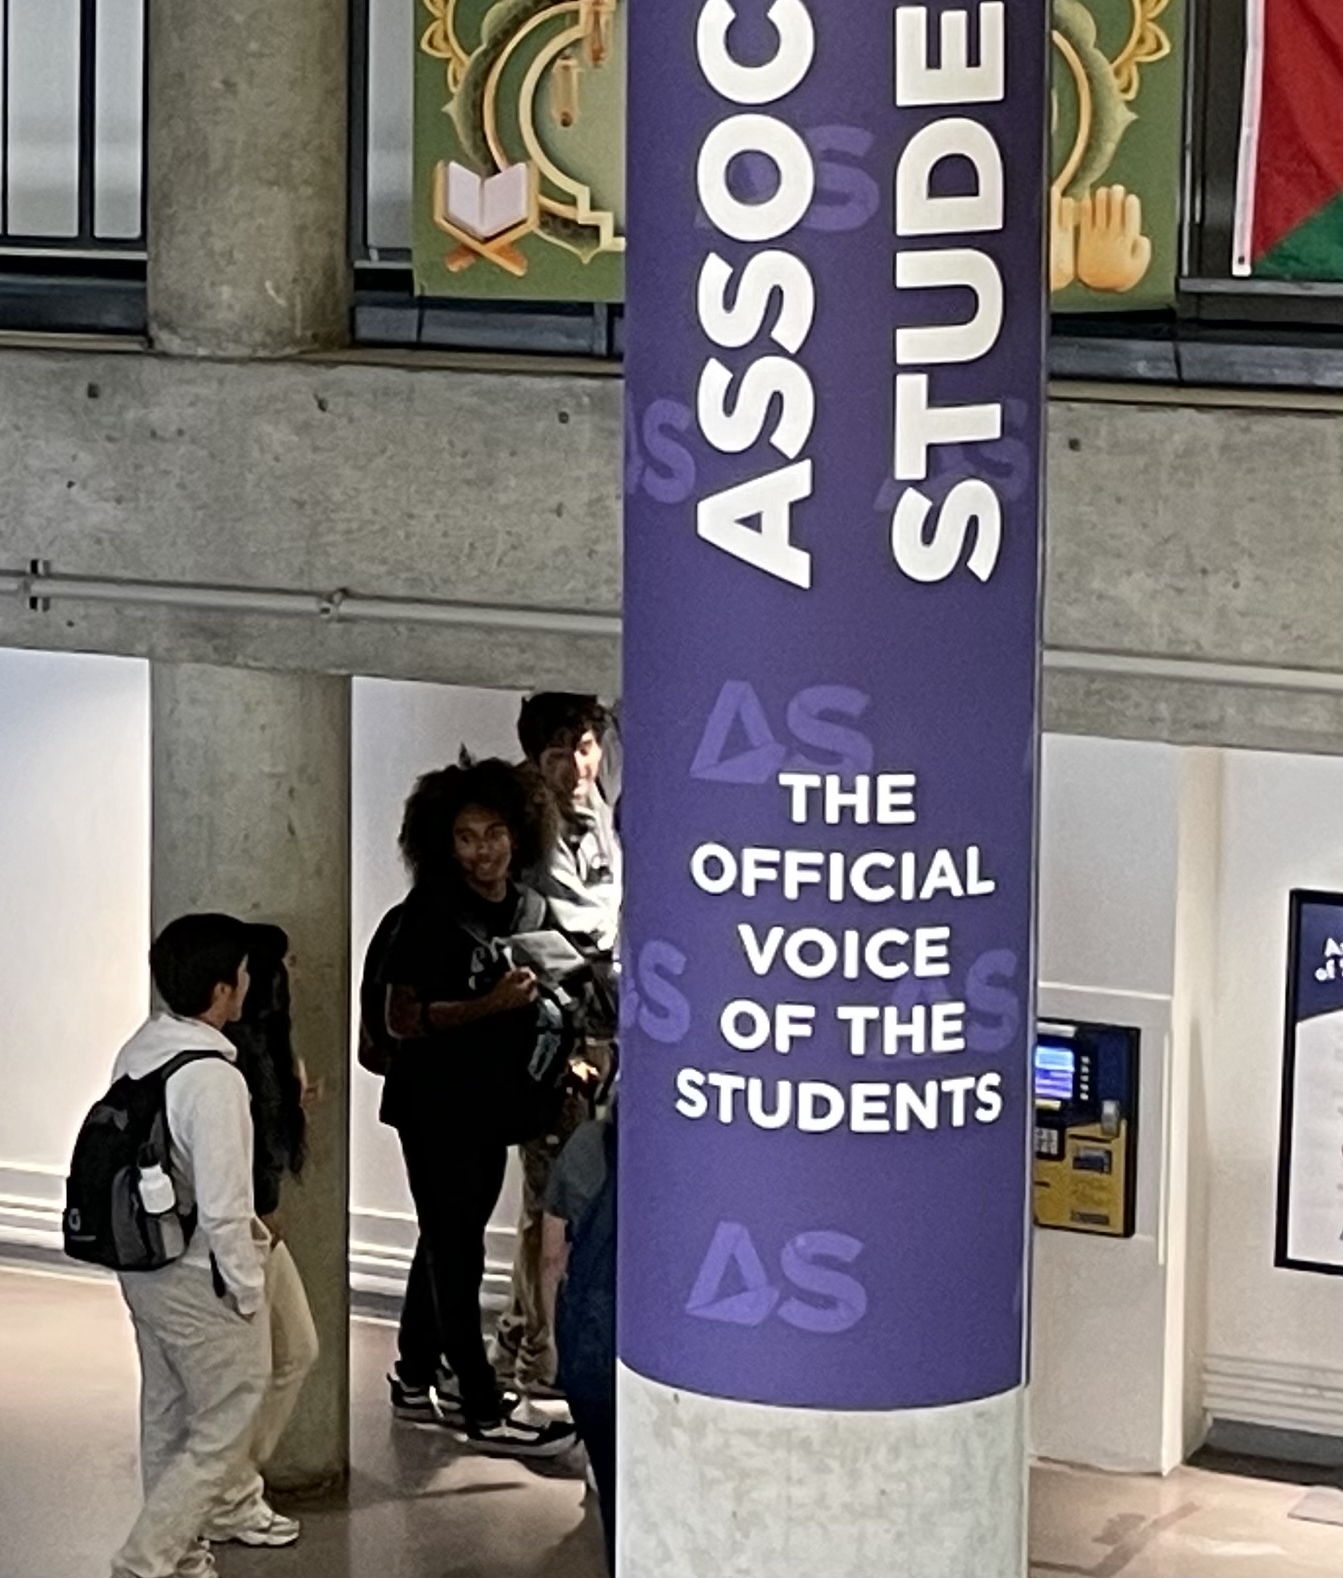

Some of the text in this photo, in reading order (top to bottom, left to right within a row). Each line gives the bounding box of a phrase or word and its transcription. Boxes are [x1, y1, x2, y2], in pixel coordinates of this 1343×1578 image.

[696, 0, 815, 590] ASSOC
[891, 0, 1005, 584] STUDE
[778, 772, 916, 826] THE
[690, 842, 995, 902] OFFICIAL
[737, 923, 951, 981] VOICE
[719, 998, 966, 1056] OF THE
[674, 1067, 1003, 1133] STUDENTS
